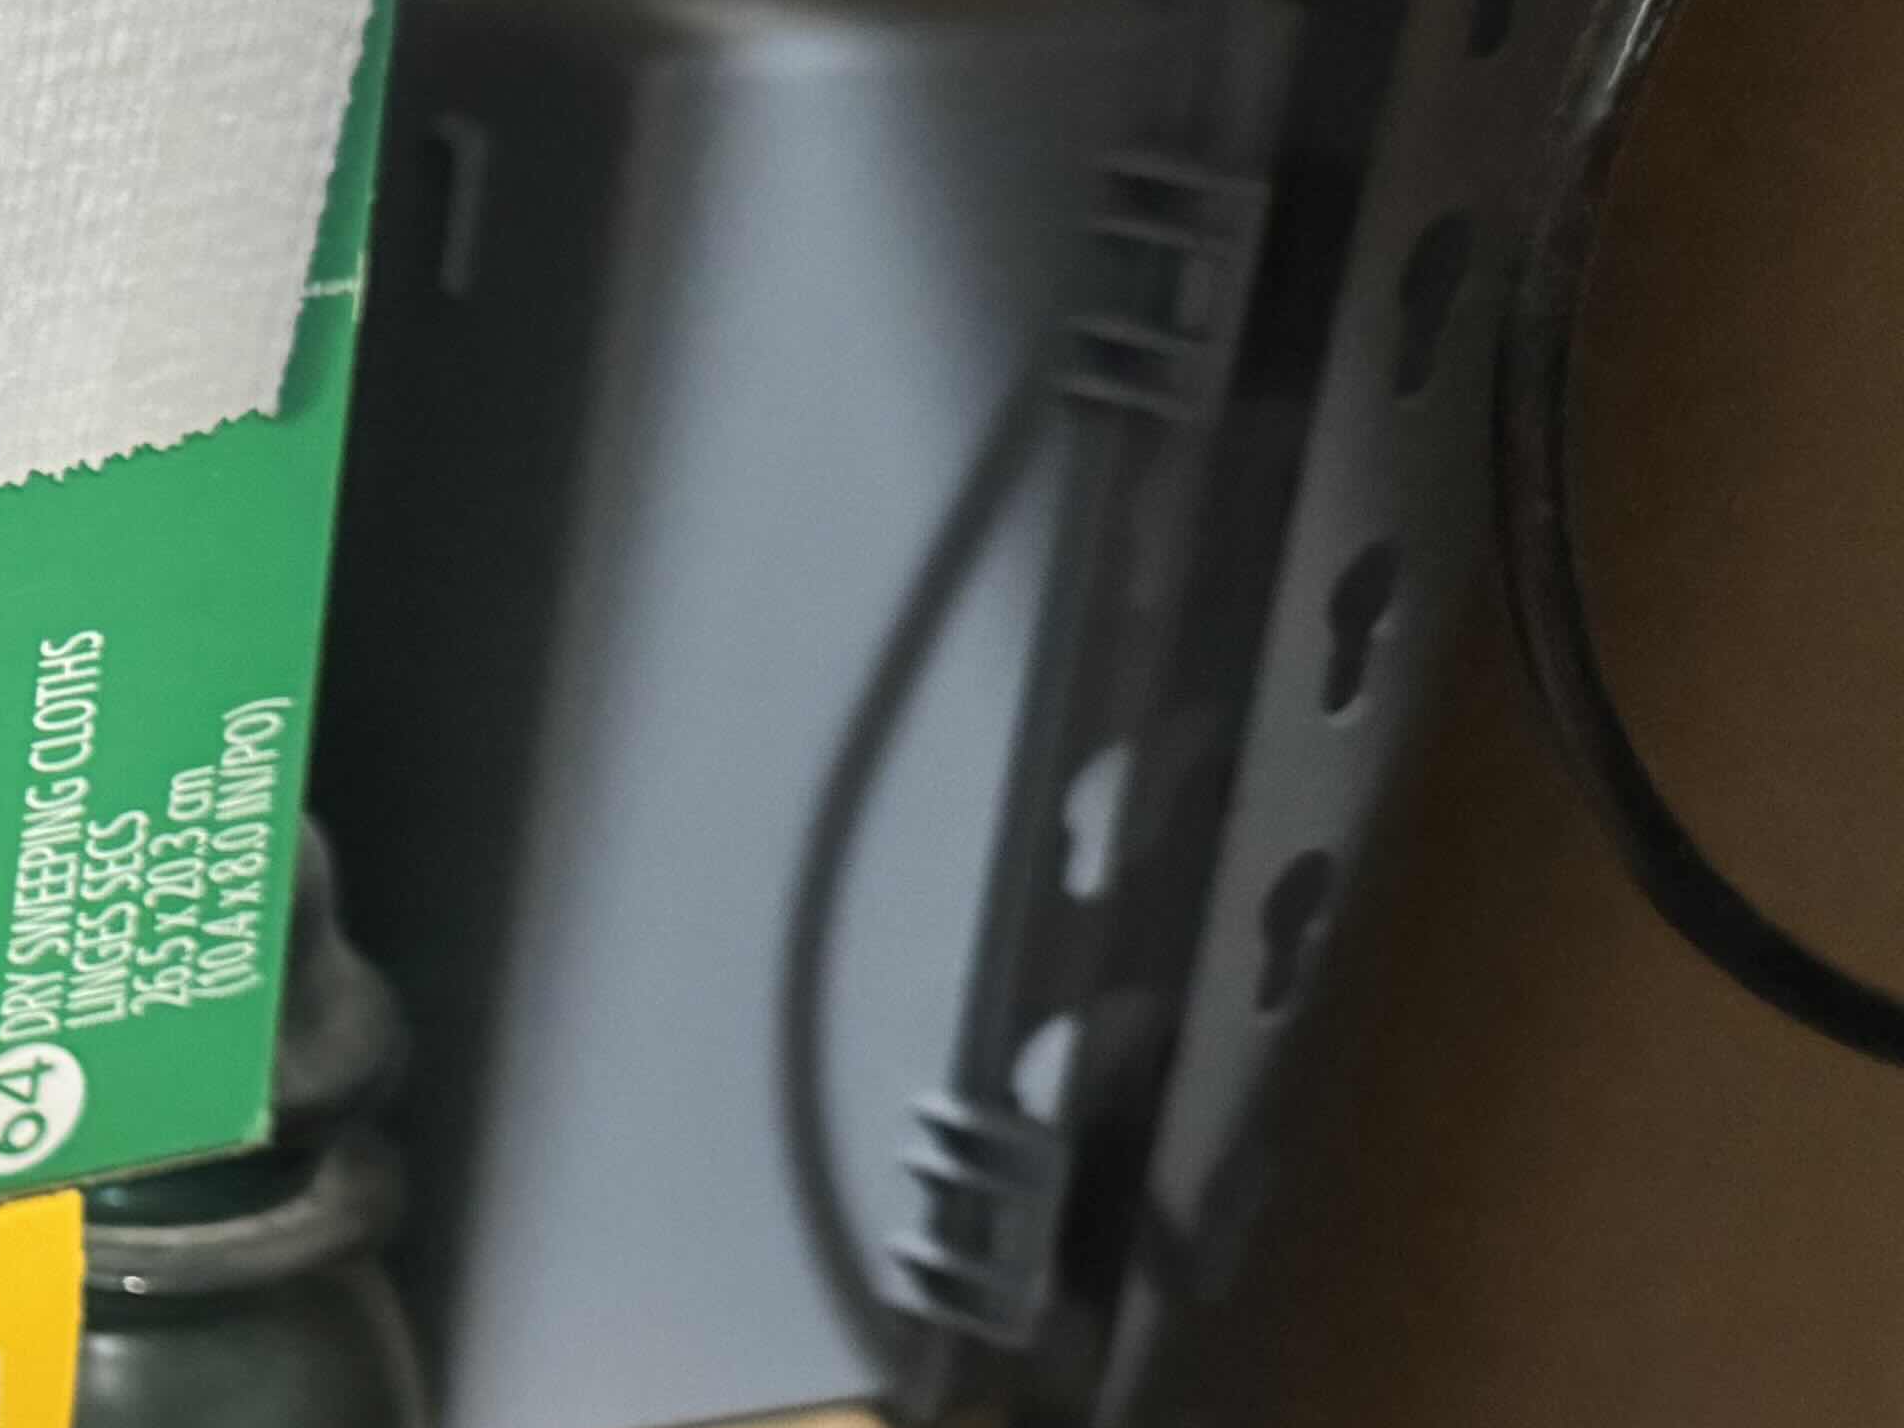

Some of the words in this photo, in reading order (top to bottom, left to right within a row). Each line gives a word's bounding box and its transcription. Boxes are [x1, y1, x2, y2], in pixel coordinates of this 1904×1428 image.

[30, 629, 106, 773] CLOTHS
[166, 763, 215, 822] cm
[215, 695, 293, 821] IN/PO)
[8, 779, 86, 964] SWEEPING
[81, 810, 150, 899] SECS
[145, 826, 211, 907] 20.3
[208, 821, 273, 884] 8.0
[155, 906, 198, 933] x
[220, 881, 263, 907] x
[66, 902, 138, 1027] LINGES
[132, 936, 198, 1015] 26.5
